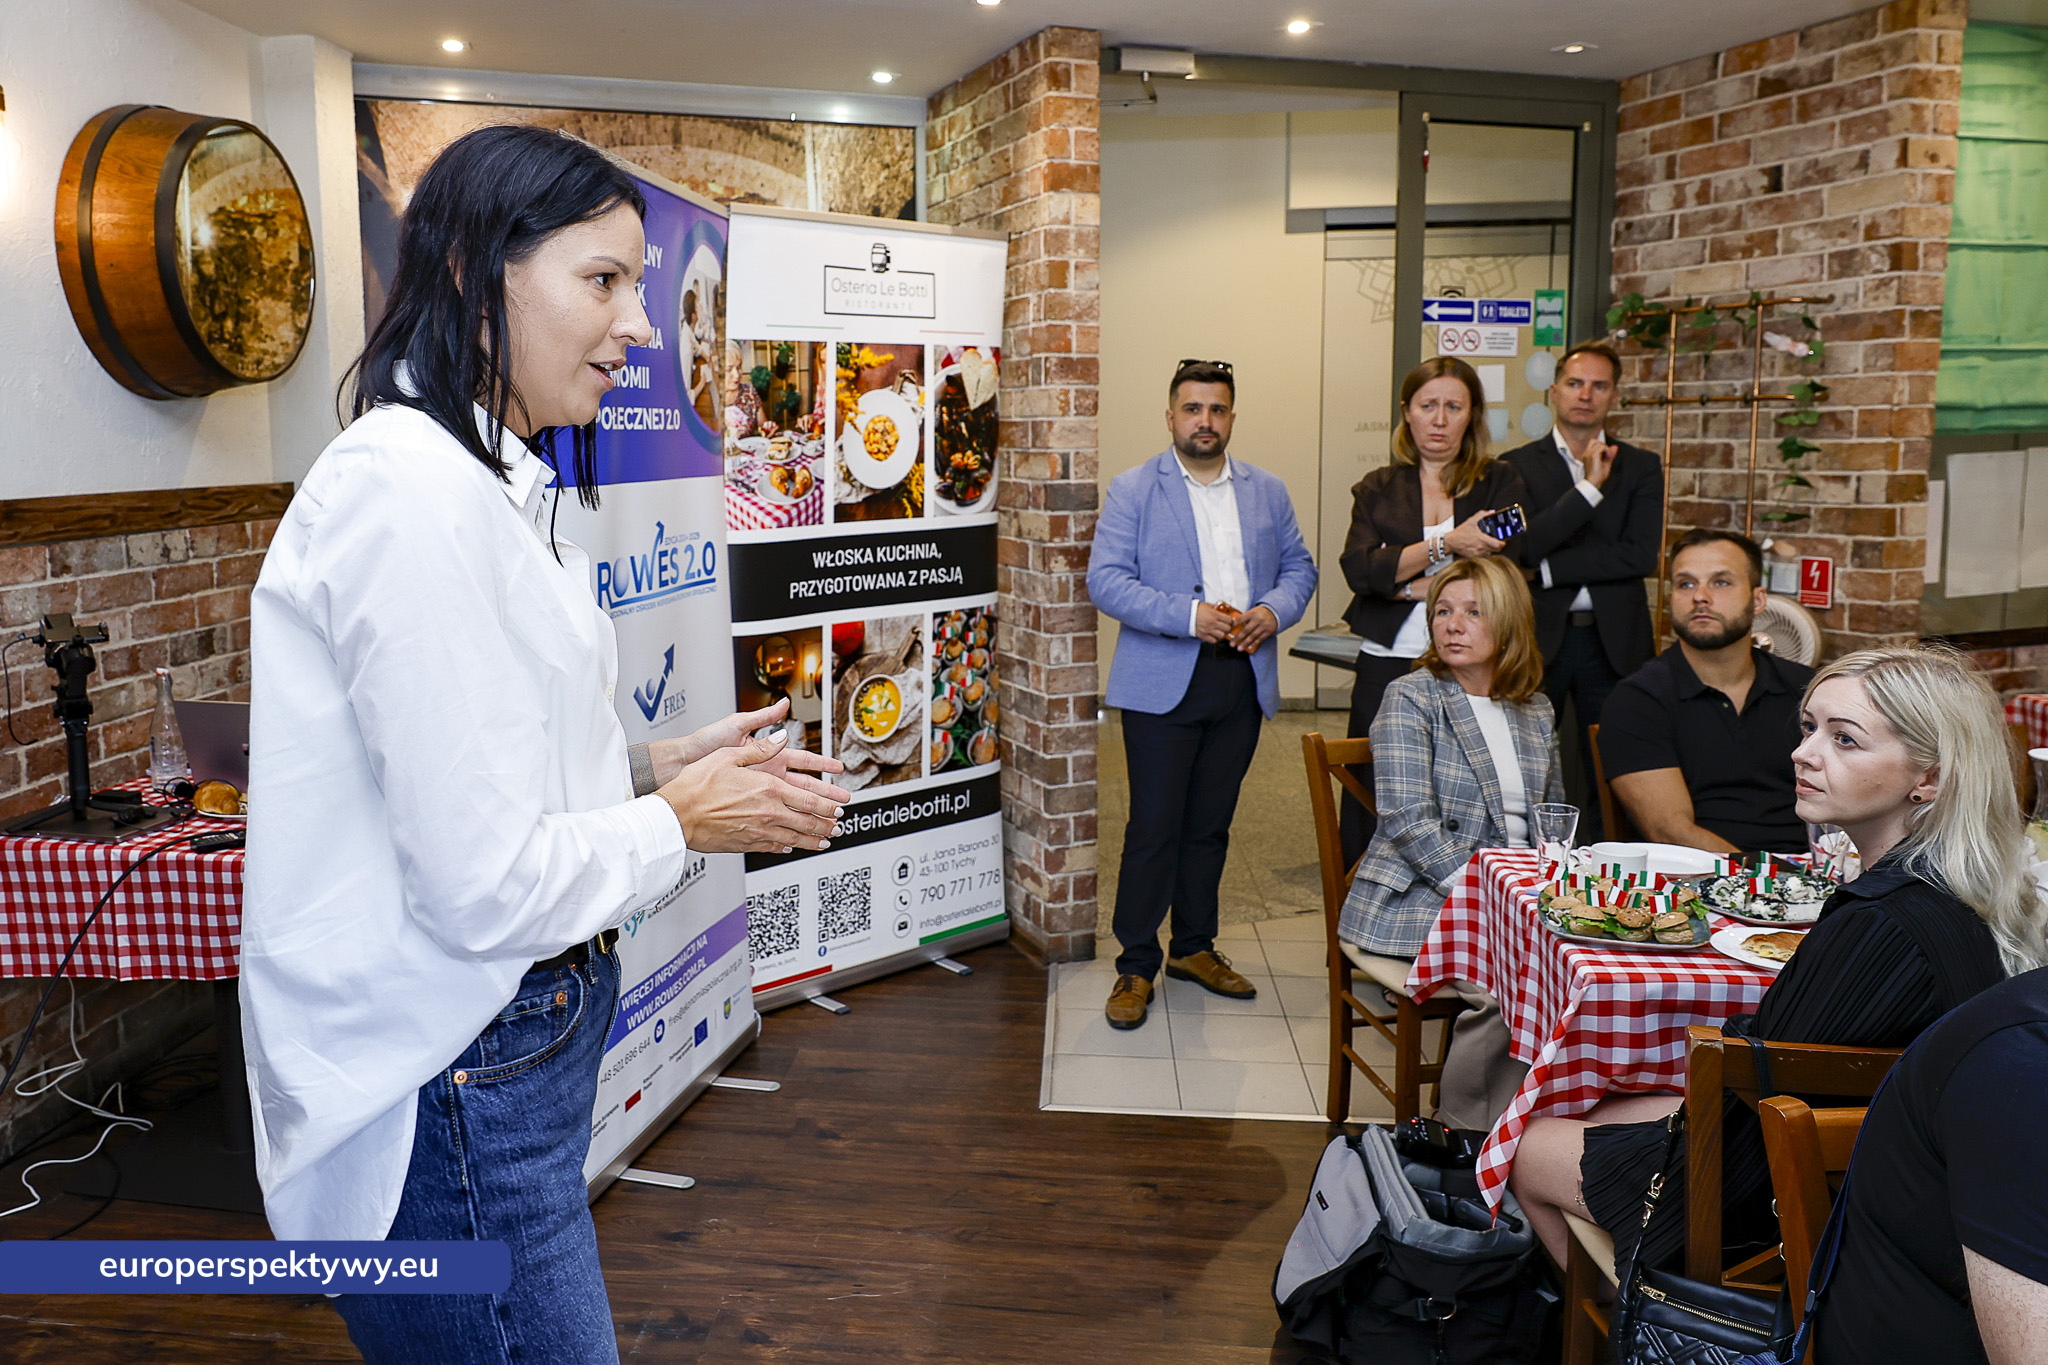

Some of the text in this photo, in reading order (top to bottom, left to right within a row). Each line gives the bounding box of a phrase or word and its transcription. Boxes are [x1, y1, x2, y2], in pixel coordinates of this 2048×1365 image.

[831, 277, 928, 298] Osteria Le Botti
[610, 364, 650, 390] NOMII
[683, 540, 716, 581] 2.0
[812, 542, 942, 569] WŁOSKA KUCHNIA,
[789, 565, 964, 600] PRZYGOTOWANA Z PASJĄ
[664, 689, 686, 717] FRES
[836, 789, 971, 837] osterialebotti.pl
[932, 847, 956, 861] Jana
[958, 839, 990, 854] Barona
[692, 856, 706, 876] 3.0
[919, 857, 977, 877] 43-100 Tychy
[920, 868, 1001, 905] 790 771 778
[621, 934, 709, 1012] WIĘCEJ INFORMACJI NA
[627, 956, 708, 1031] WWW.ROWES.COM.PL
